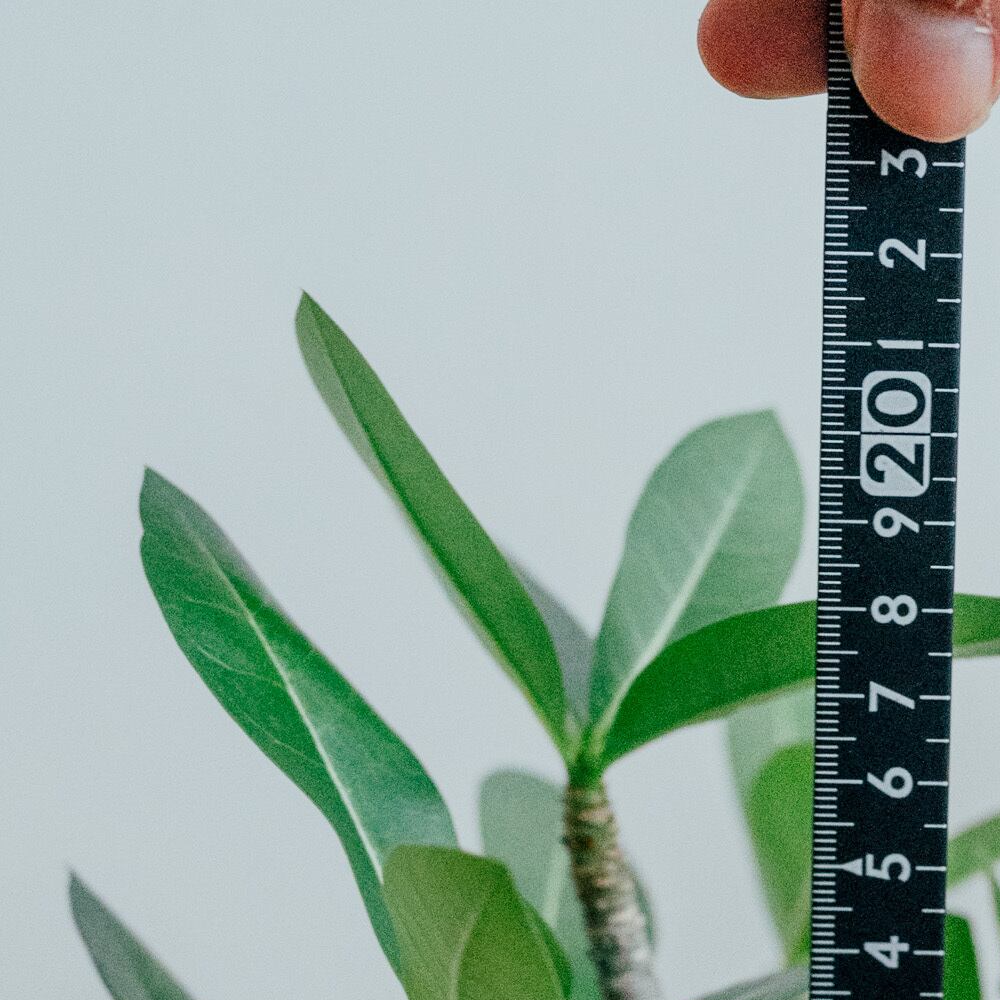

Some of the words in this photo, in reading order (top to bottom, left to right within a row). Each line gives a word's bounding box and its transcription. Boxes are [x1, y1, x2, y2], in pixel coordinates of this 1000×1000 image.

[880, 148, 928, 179] 3
[878, 238, 927, 271] 2
[876, 339, 924, 349] 1
[865, 377, 926, 487] 20
[872, 507, 920, 538] 9
[870, 594, 918, 627] 8
[868, 680, 915, 713] 7
[867, 766, 914, 799] 6
[865, 852, 912, 883] 5
[863, 935, 910, 969] 4
